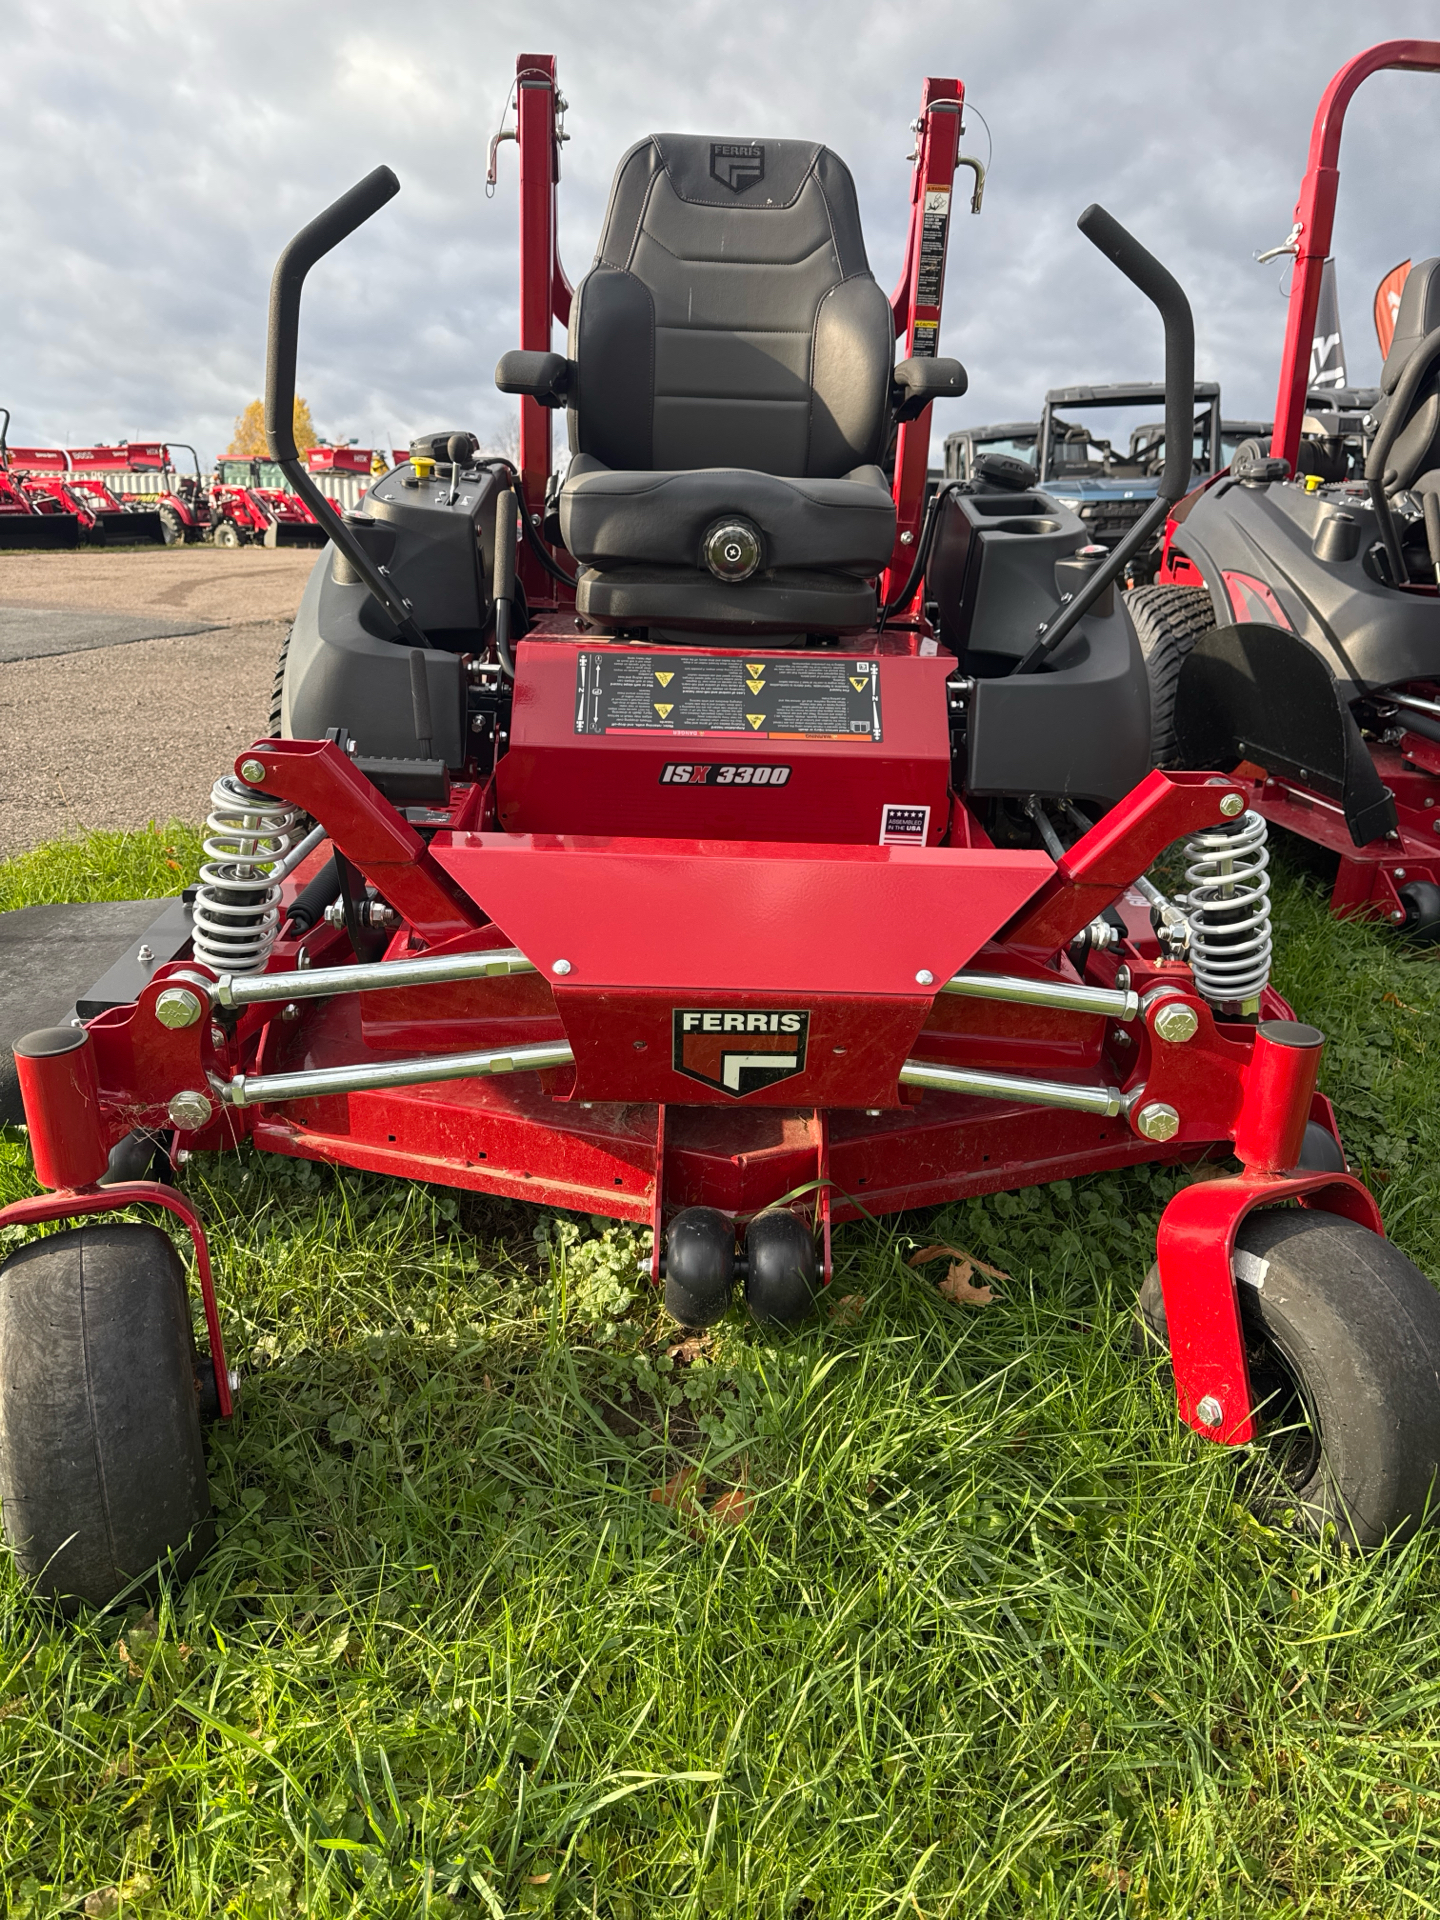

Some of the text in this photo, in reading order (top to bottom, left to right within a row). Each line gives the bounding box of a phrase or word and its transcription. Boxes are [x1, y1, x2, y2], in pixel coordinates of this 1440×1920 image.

[714, 145, 761, 156] FERRIS
[662, 765, 790, 785] ISX 3300
[683, 1012, 801, 1032] FERRIS
